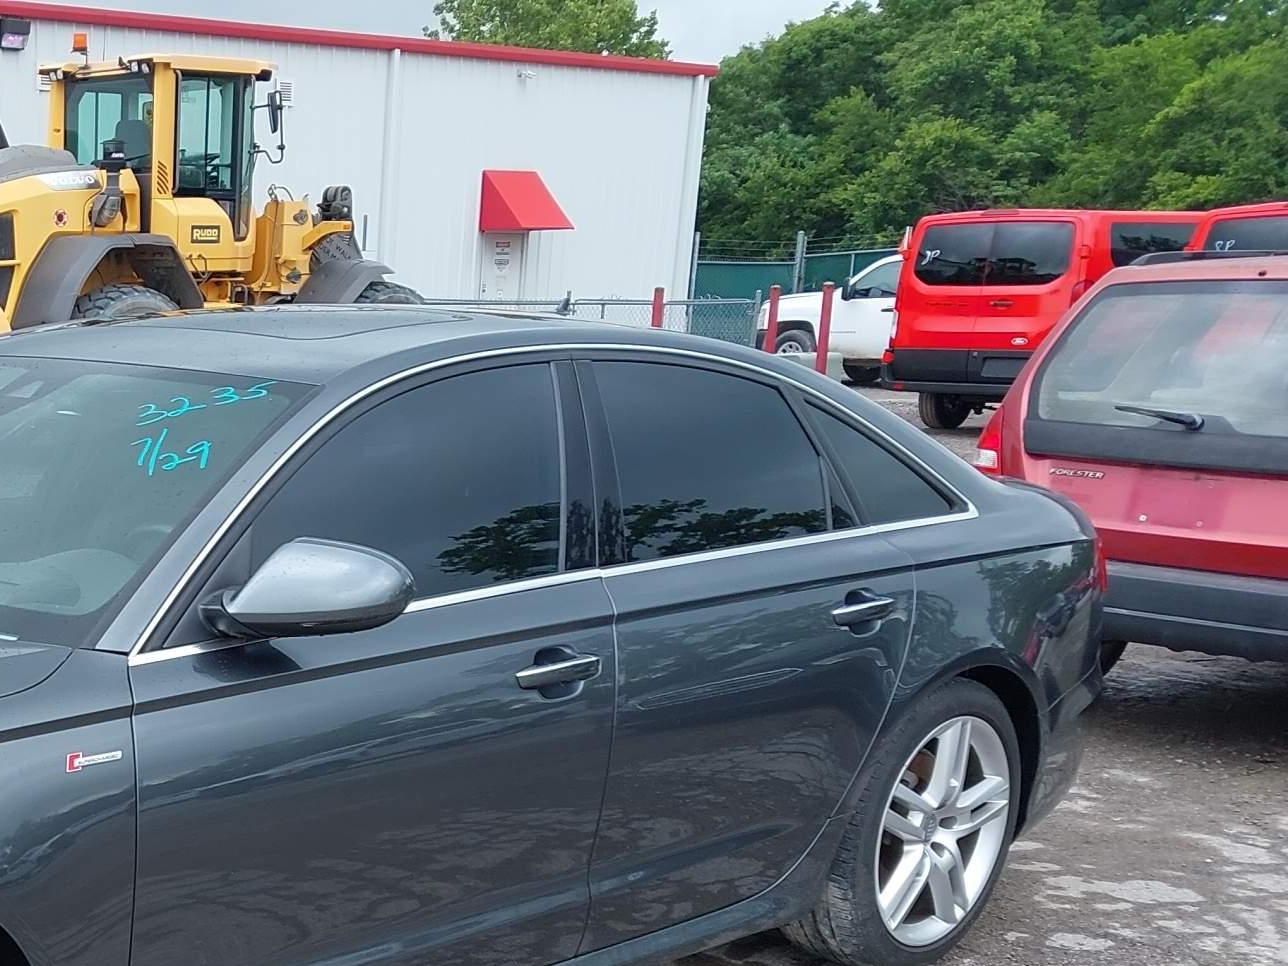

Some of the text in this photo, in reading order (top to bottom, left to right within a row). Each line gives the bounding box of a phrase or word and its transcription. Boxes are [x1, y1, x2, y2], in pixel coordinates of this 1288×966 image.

[193, 228, 219, 240] RUDD
[130, 427, 212, 477] 7/29
[1049, 467, 1105, 480] FORESTER
